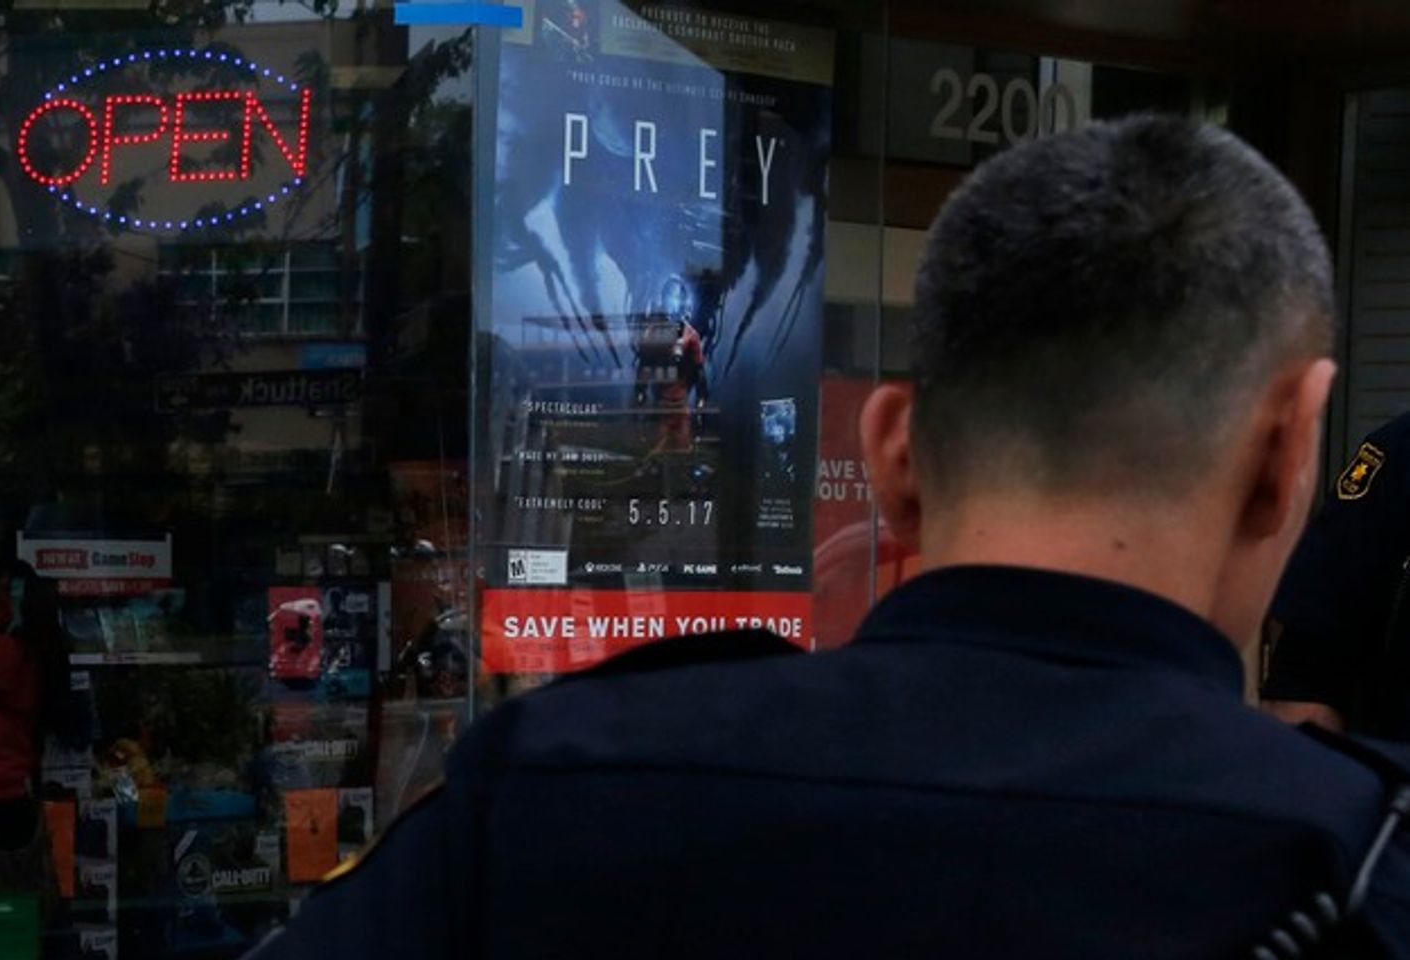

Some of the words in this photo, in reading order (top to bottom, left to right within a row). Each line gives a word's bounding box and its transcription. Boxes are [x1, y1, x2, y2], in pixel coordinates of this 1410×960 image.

[930, 67, 1077, 146] 2200
[17, 87, 312, 187] OPEN
[563, 112, 778, 206] PREY
[816, 459, 855, 481] AVE
[817, 481, 847, 502] OU
[629, 498, 714, 526] 5.5.17
[504, 616, 576, 638] SAVE
[587, 616, 666, 638] WHEN
[676, 617, 727, 637] YOU
